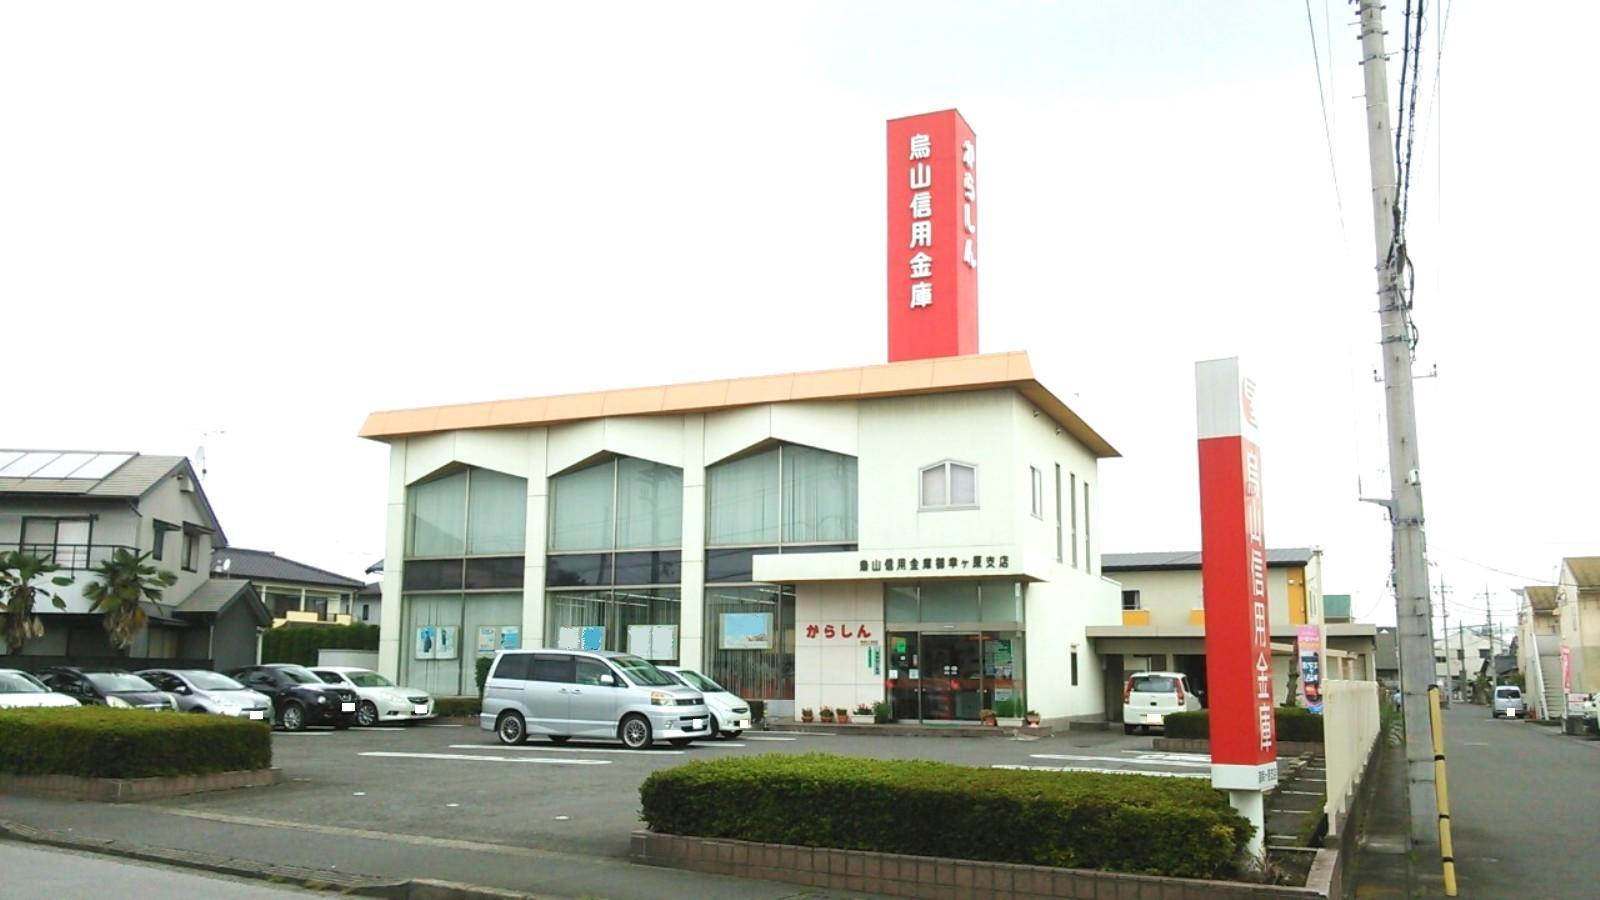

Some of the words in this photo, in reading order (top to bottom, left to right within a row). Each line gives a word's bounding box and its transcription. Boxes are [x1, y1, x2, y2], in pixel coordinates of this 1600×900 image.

[909, 133, 933, 309] 烏山信用金庫
[961, 140, 977, 269] からしん
[806, 623, 871, 639] からしん
